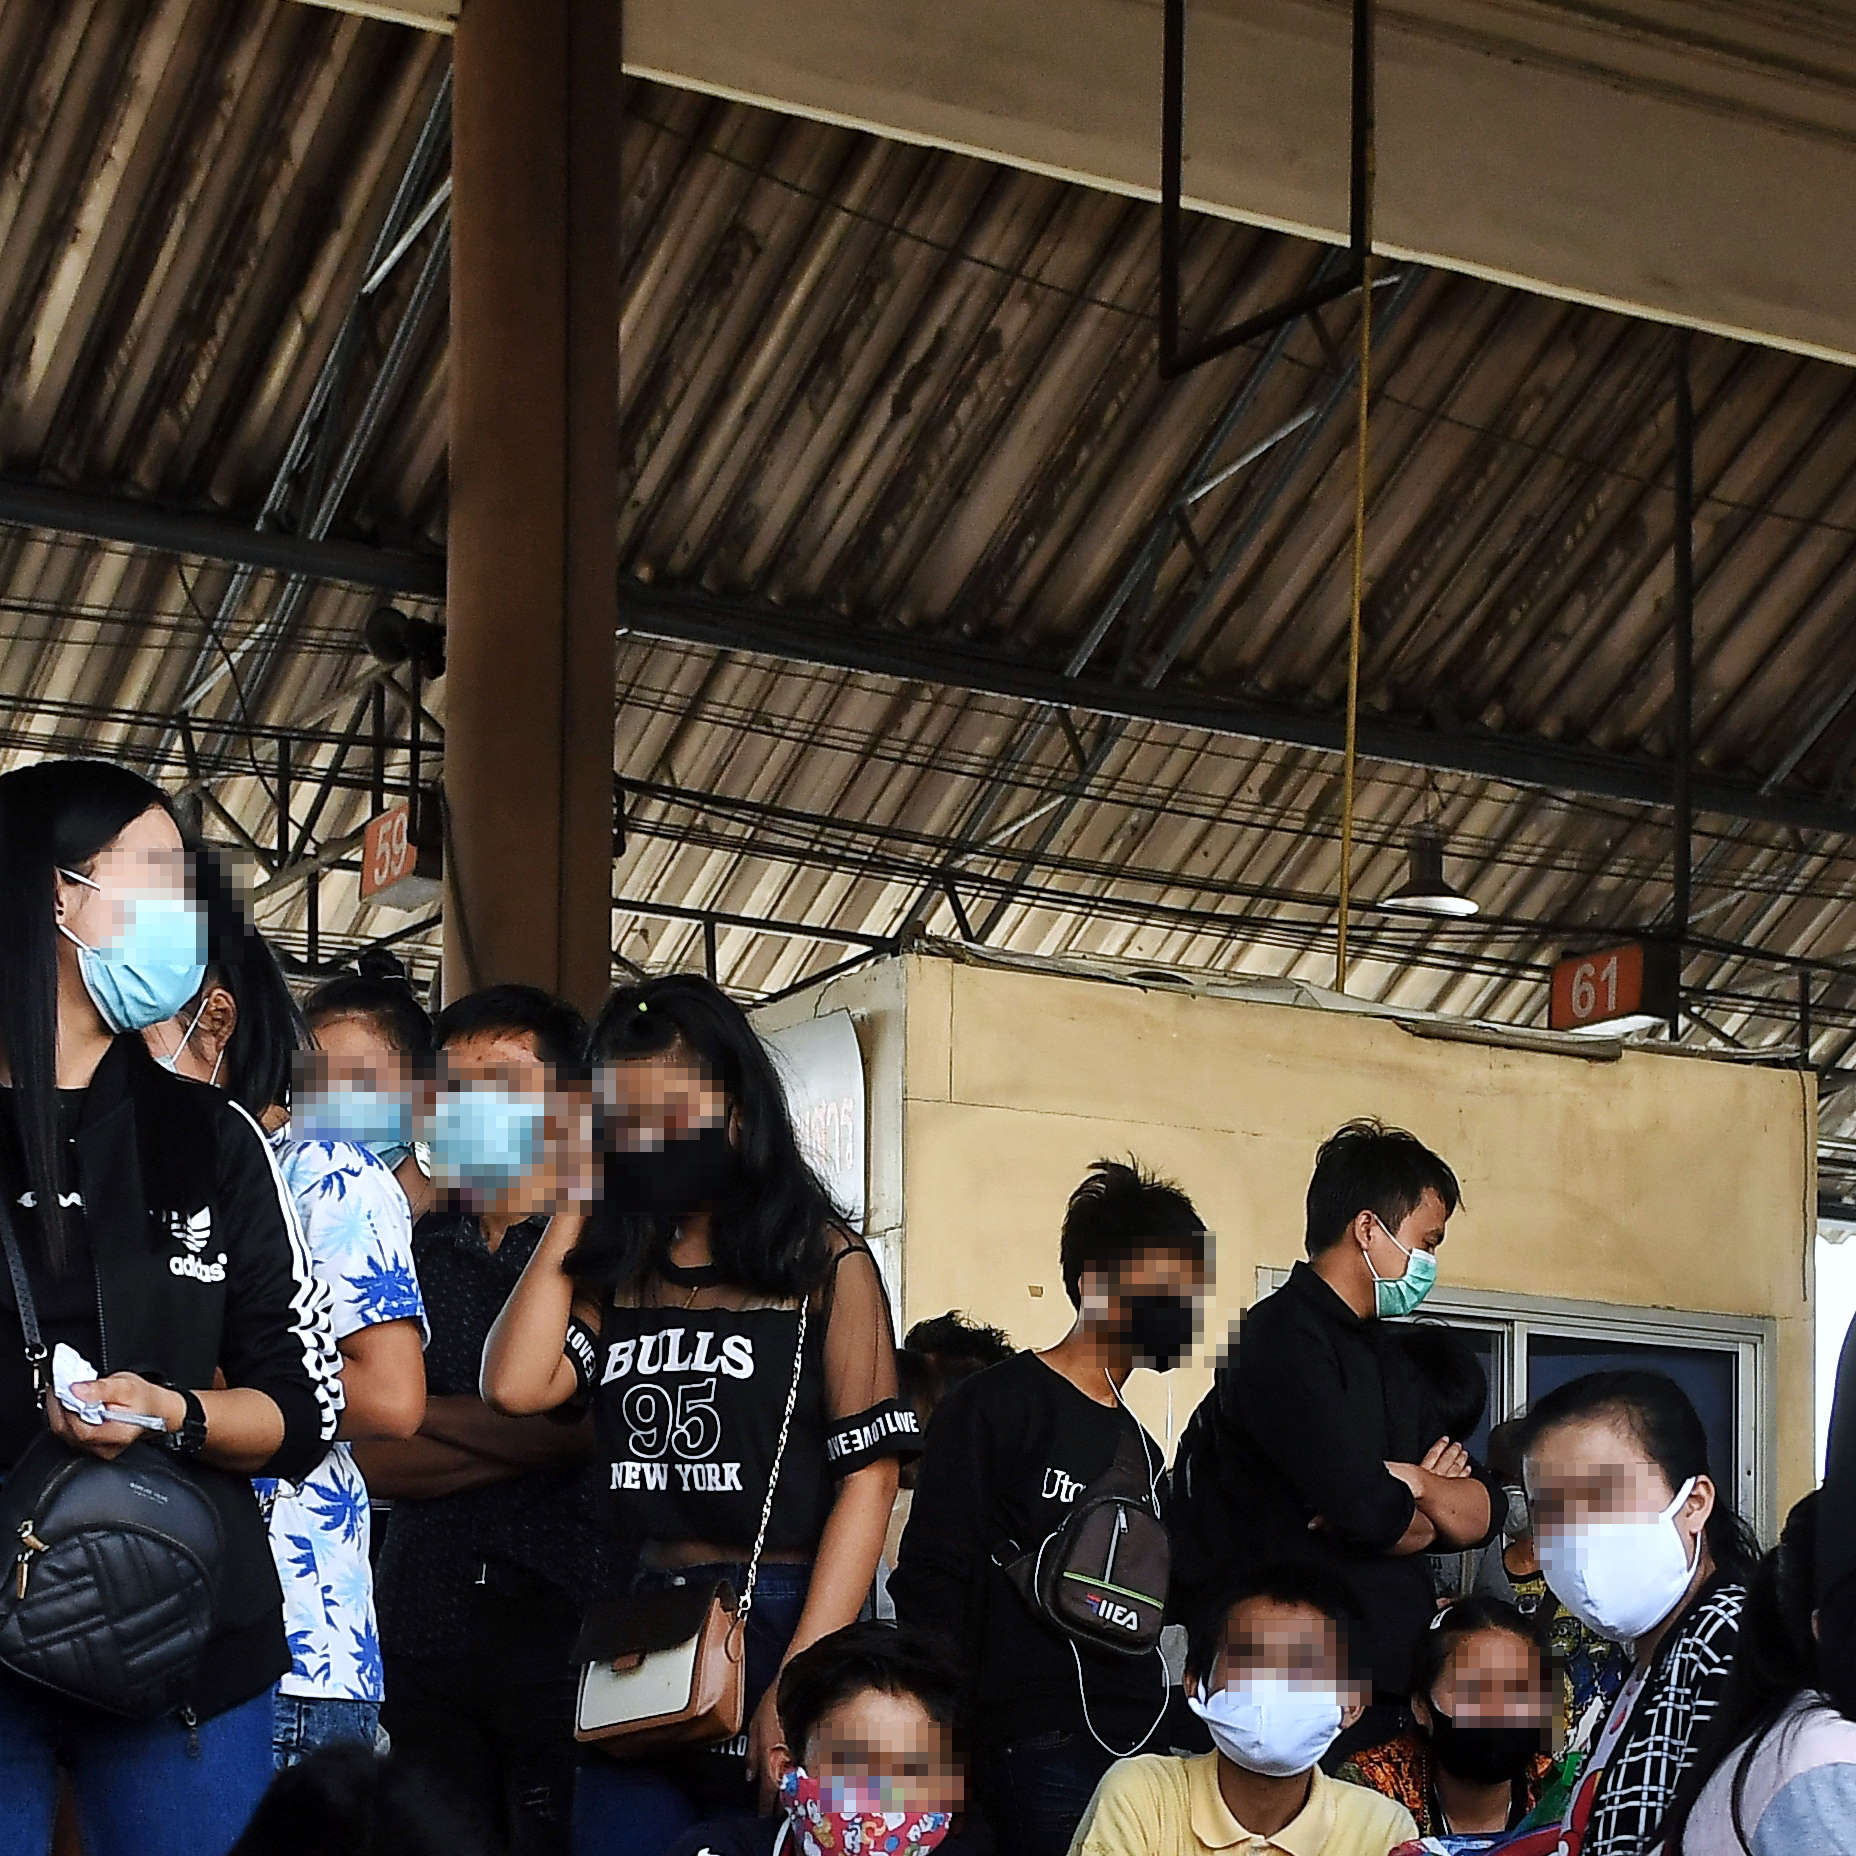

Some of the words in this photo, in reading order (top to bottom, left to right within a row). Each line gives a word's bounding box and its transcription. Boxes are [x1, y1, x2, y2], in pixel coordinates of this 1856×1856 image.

[374, 812, 408, 886] 59
[1572, 955, 1617, 1018] 61
[600, 1327, 755, 1386] BULLS
[622, 1378, 721, 1459] 95
[610, 1462, 669, 1490] NEW
[674, 1462, 743, 1492] YORK
